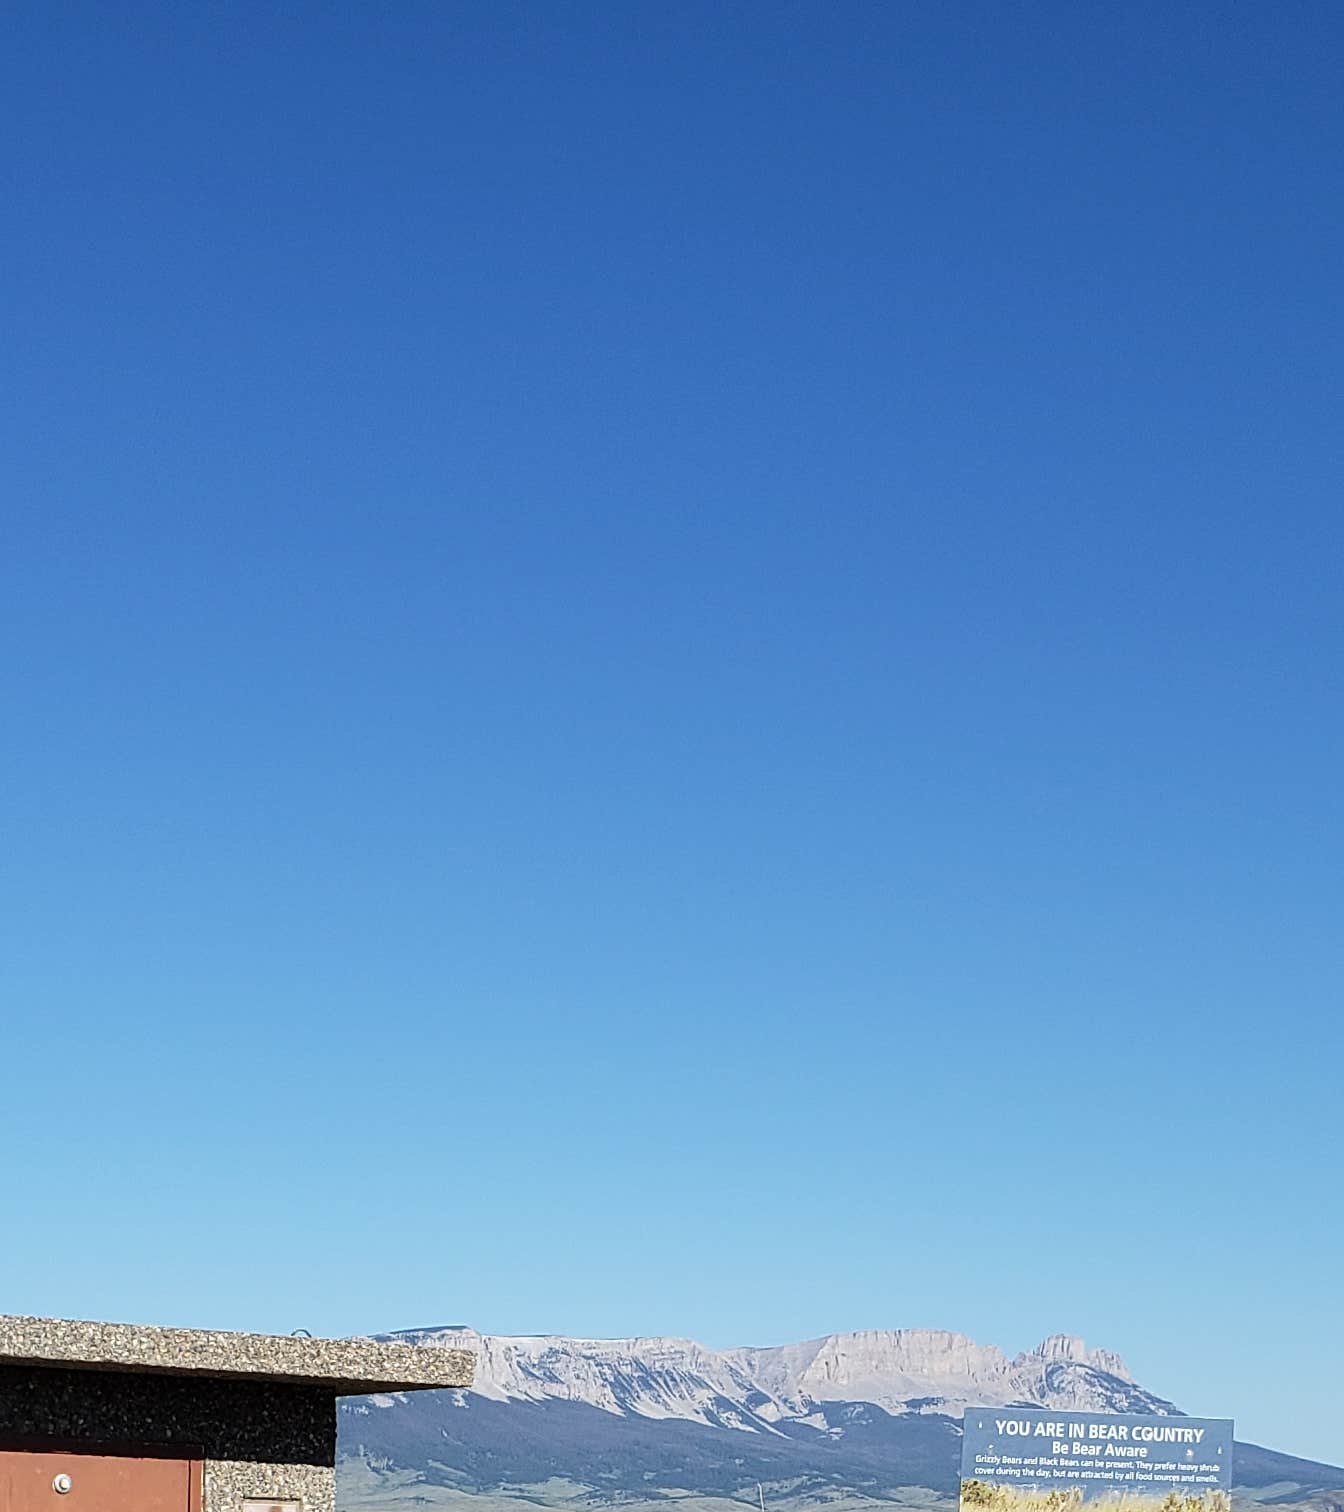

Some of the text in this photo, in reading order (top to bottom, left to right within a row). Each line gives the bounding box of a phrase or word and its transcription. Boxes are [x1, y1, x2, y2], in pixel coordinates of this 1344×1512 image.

[996, 1420, 1204, 1443] YOU ARE IN BEAR COUNTRY
[1052, 1441, 1148, 1457] Be Bear Aware
[975, 1454, 1000, 1465] Grizzly
[1002, 1455, 1023, 1464] Bears
[1023, 1456, 1038, 1465] and
[1039, 1457, 1058, 1466] Black
[1060, 1458, 1079, 1467] Bears
[1095, 1459, 1104, 1468] be
[1105, 1461, 1134, 1470] present.
[1136, 1460, 1153, 1471] They
[1154, 1462, 1176, 1471] prefer
[1178, 1462, 1199, 1472] heavy
[1200, 1463, 1220, 1472] shrub
[974, 1467, 994, 1475] cover
[995, 1467, 1021, 1477] during
[1022, 1467, 1035, 1476] the
[1036, 1468, 1052, 1477] day,
[1053, 1469, 1065, 1478] but
[1067, 1470, 1080, 1478] are
[1081, 1470, 1114, 1479] attracted
[1115, 1470, 1124, 1481] by
[1125, 1471, 1135, 1480] all
[1136, 1472, 1153, 1480] food
[1154, 1473, 1179, 1482] sources
[1181, 1474, 1195, 1482] and
